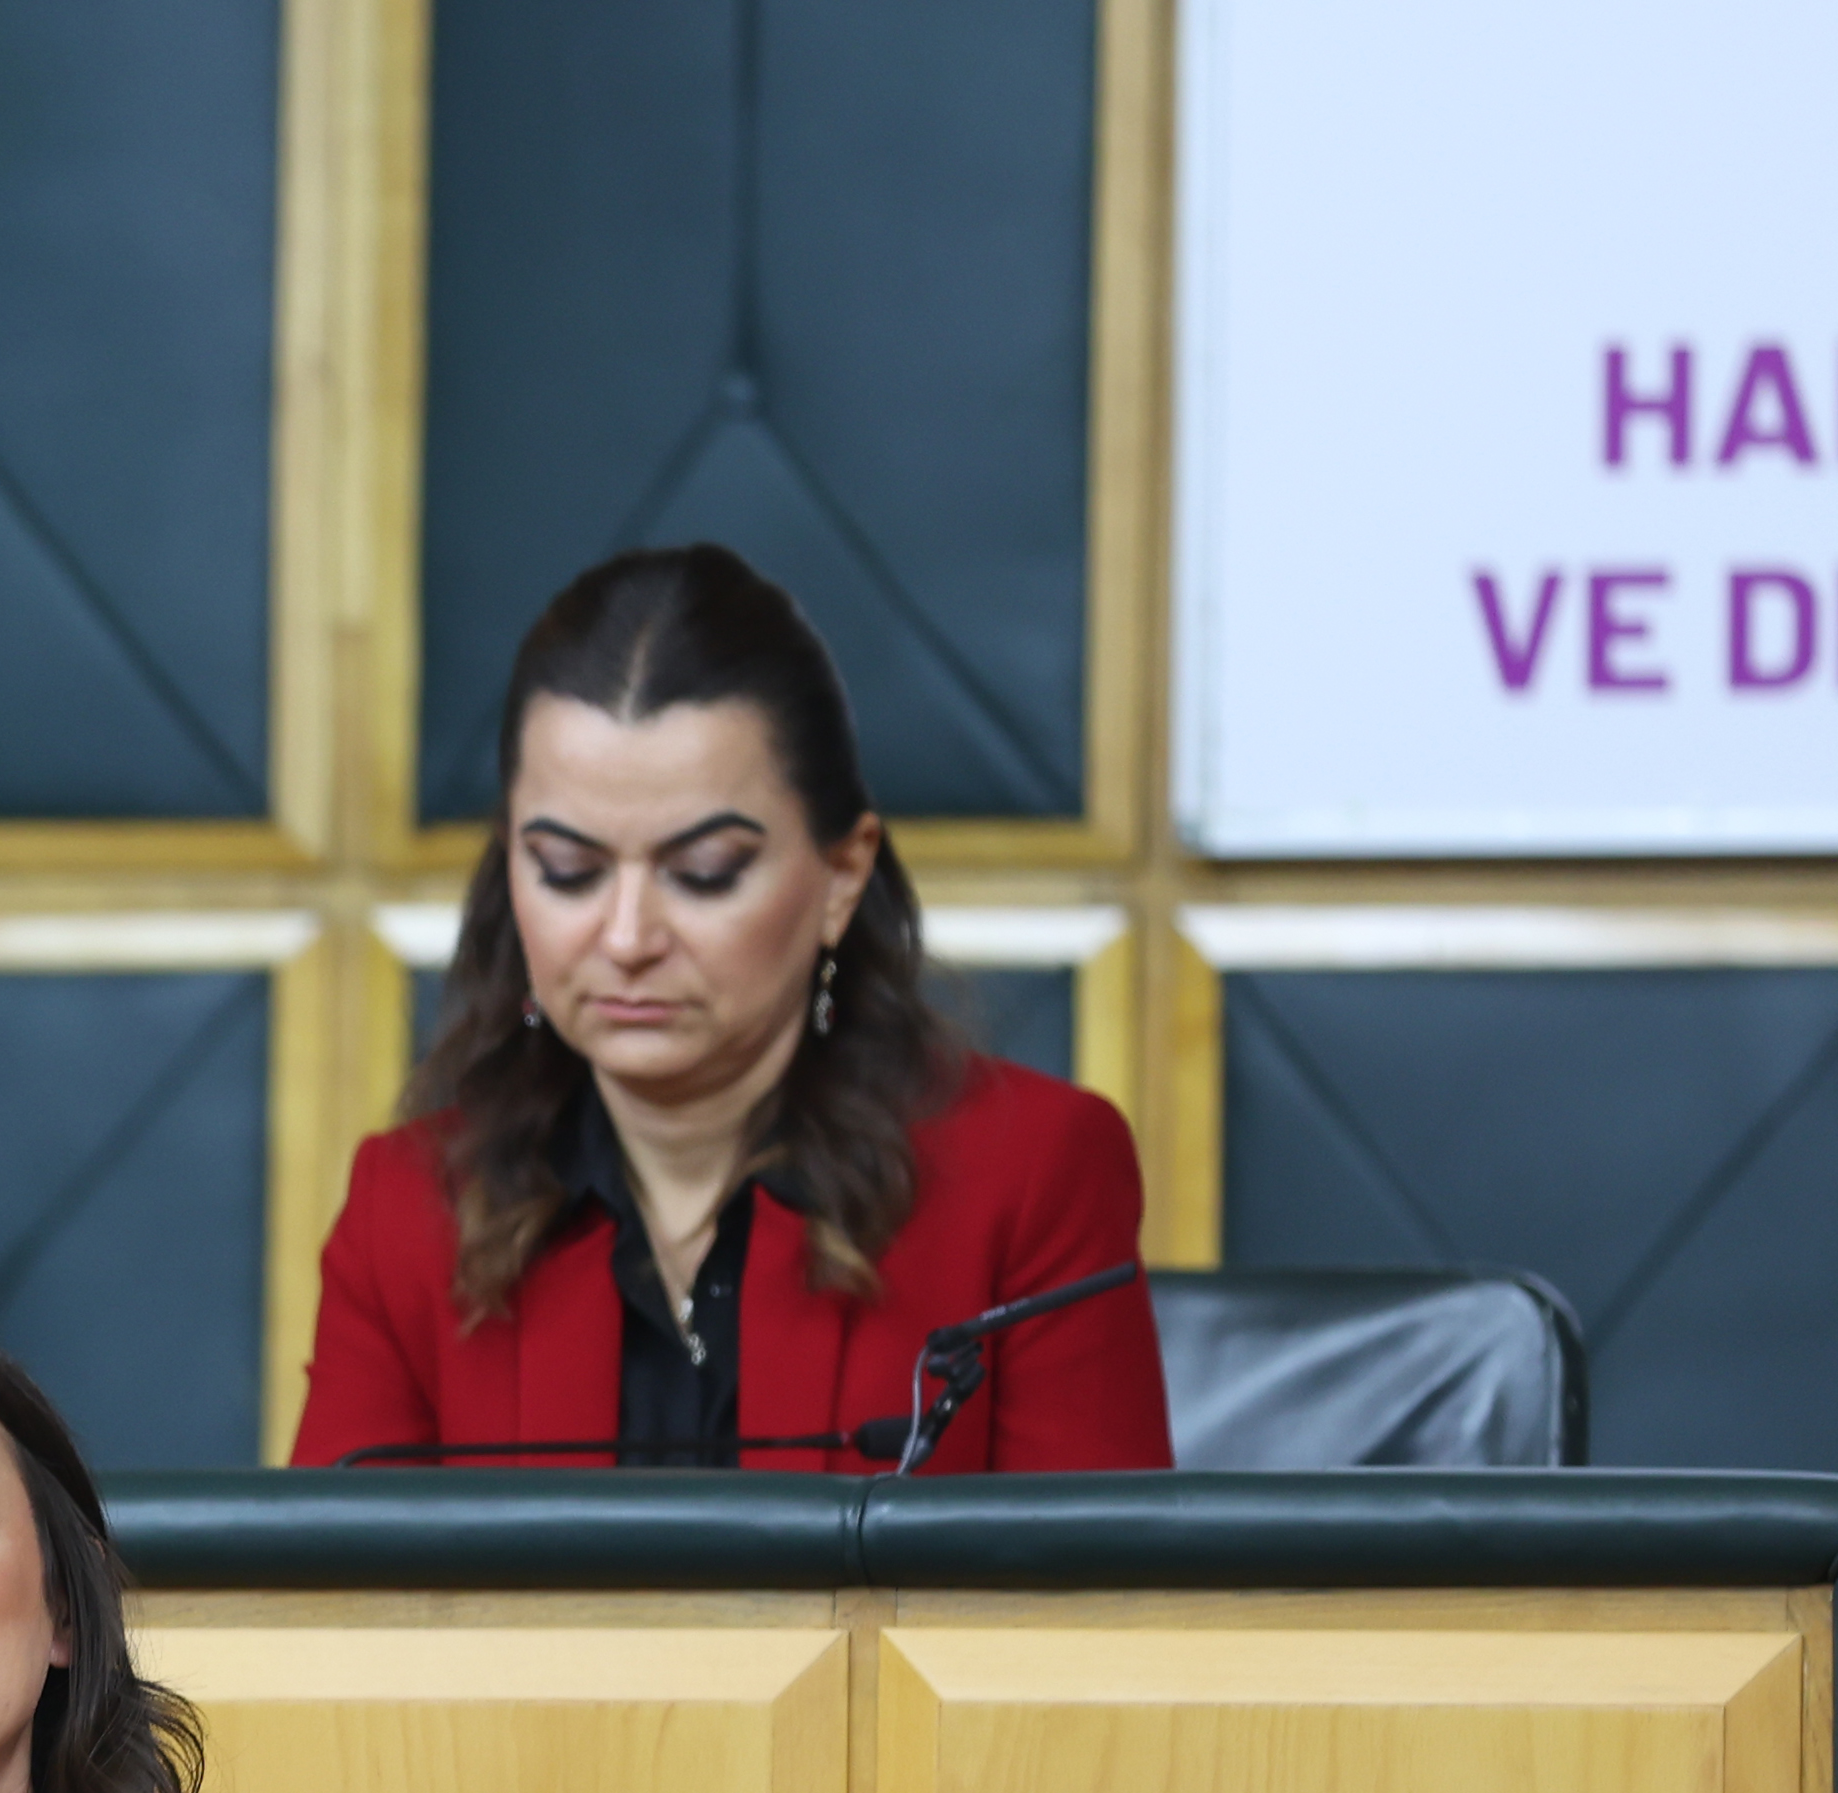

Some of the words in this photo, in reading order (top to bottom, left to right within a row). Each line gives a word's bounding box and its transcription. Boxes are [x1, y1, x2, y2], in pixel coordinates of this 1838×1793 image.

[1598, 340, 1838, 472] HA
[1470, 566, 1672, 696] VE
[1725, 566, 1838, 696] D
